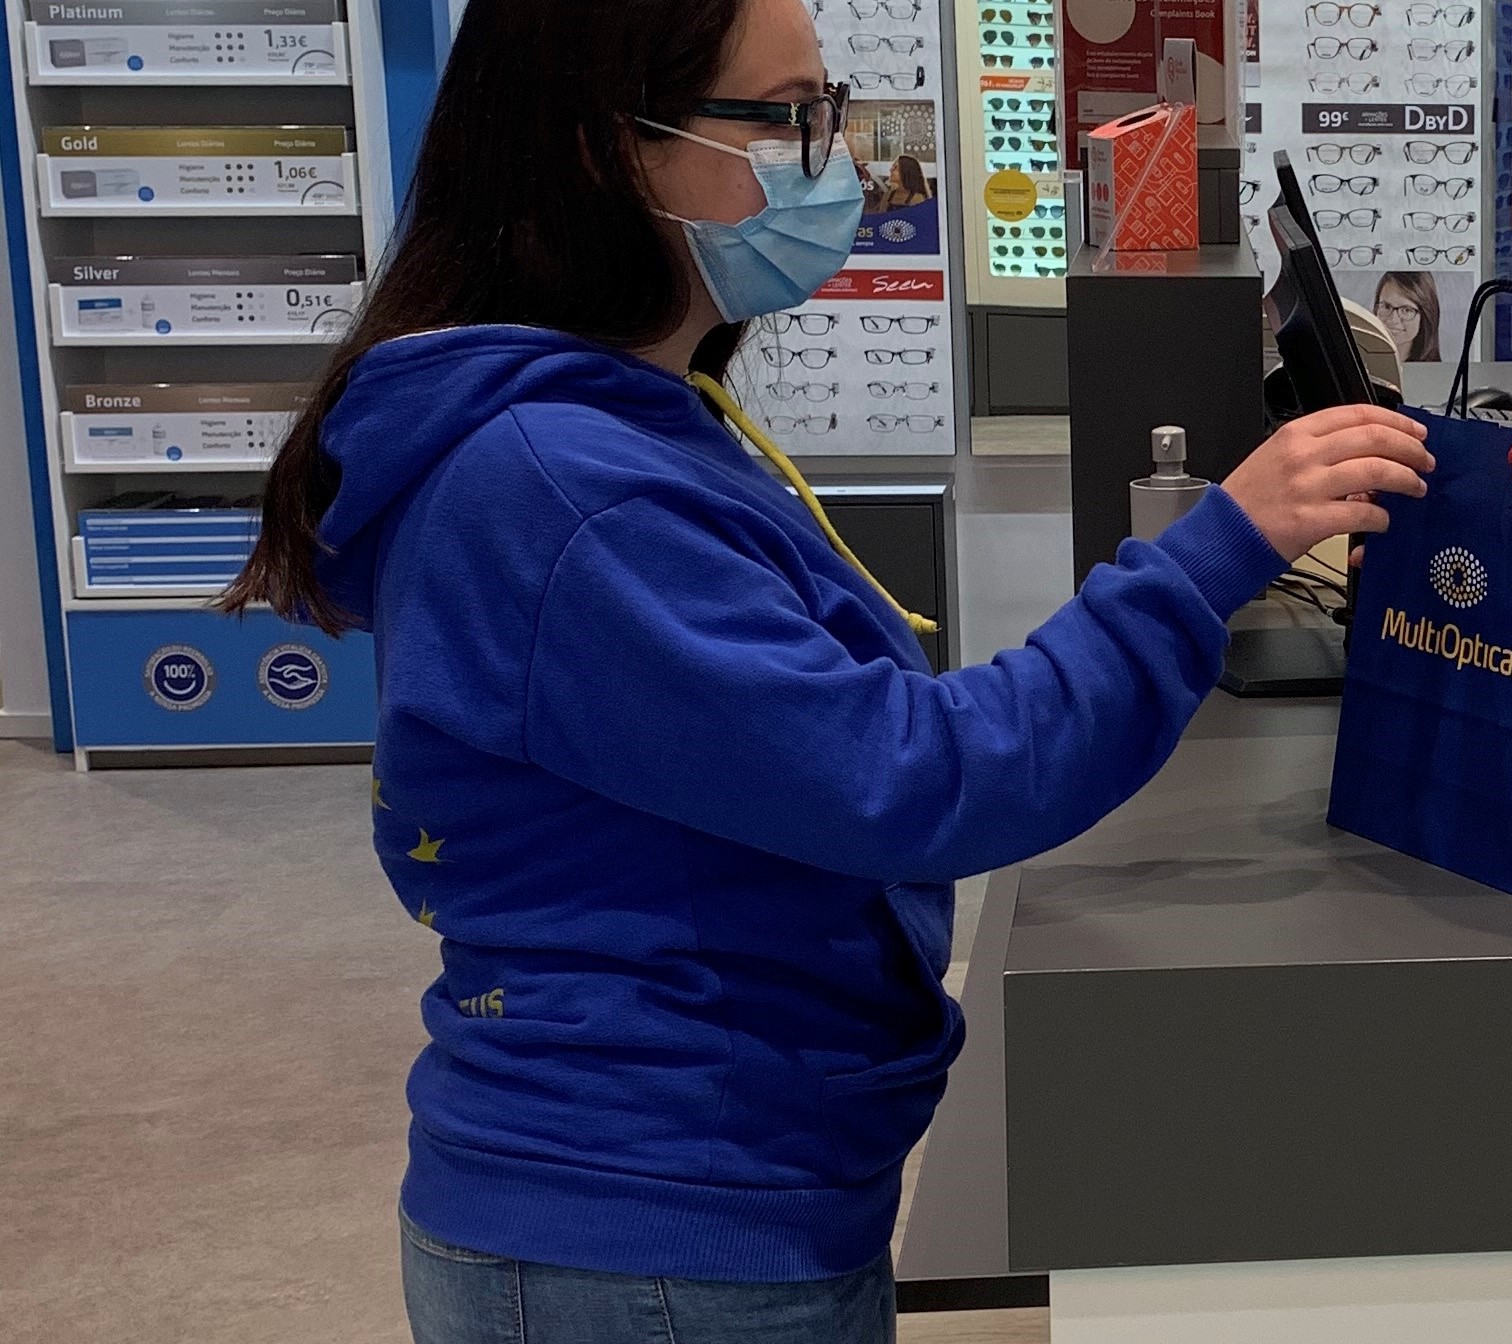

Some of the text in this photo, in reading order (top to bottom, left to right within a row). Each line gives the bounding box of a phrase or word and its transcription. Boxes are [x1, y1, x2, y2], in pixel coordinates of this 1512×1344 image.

[50, 5, 123, 19] Platinum
[1195, 10, 1215, 19] Book
[264, 29, 308, 49] 1,33€
[1319, 111, 1349, 127] 99€
[61, 136, 97, 150] Gold
[274, 160, 317, 181] 1,06€
[74, 266, 119, 280] Silver
[286, 289, 334, 308] 0,51€
[85, 395, 141, 408] Bronze
[164, 664, 196, 678] 100%
